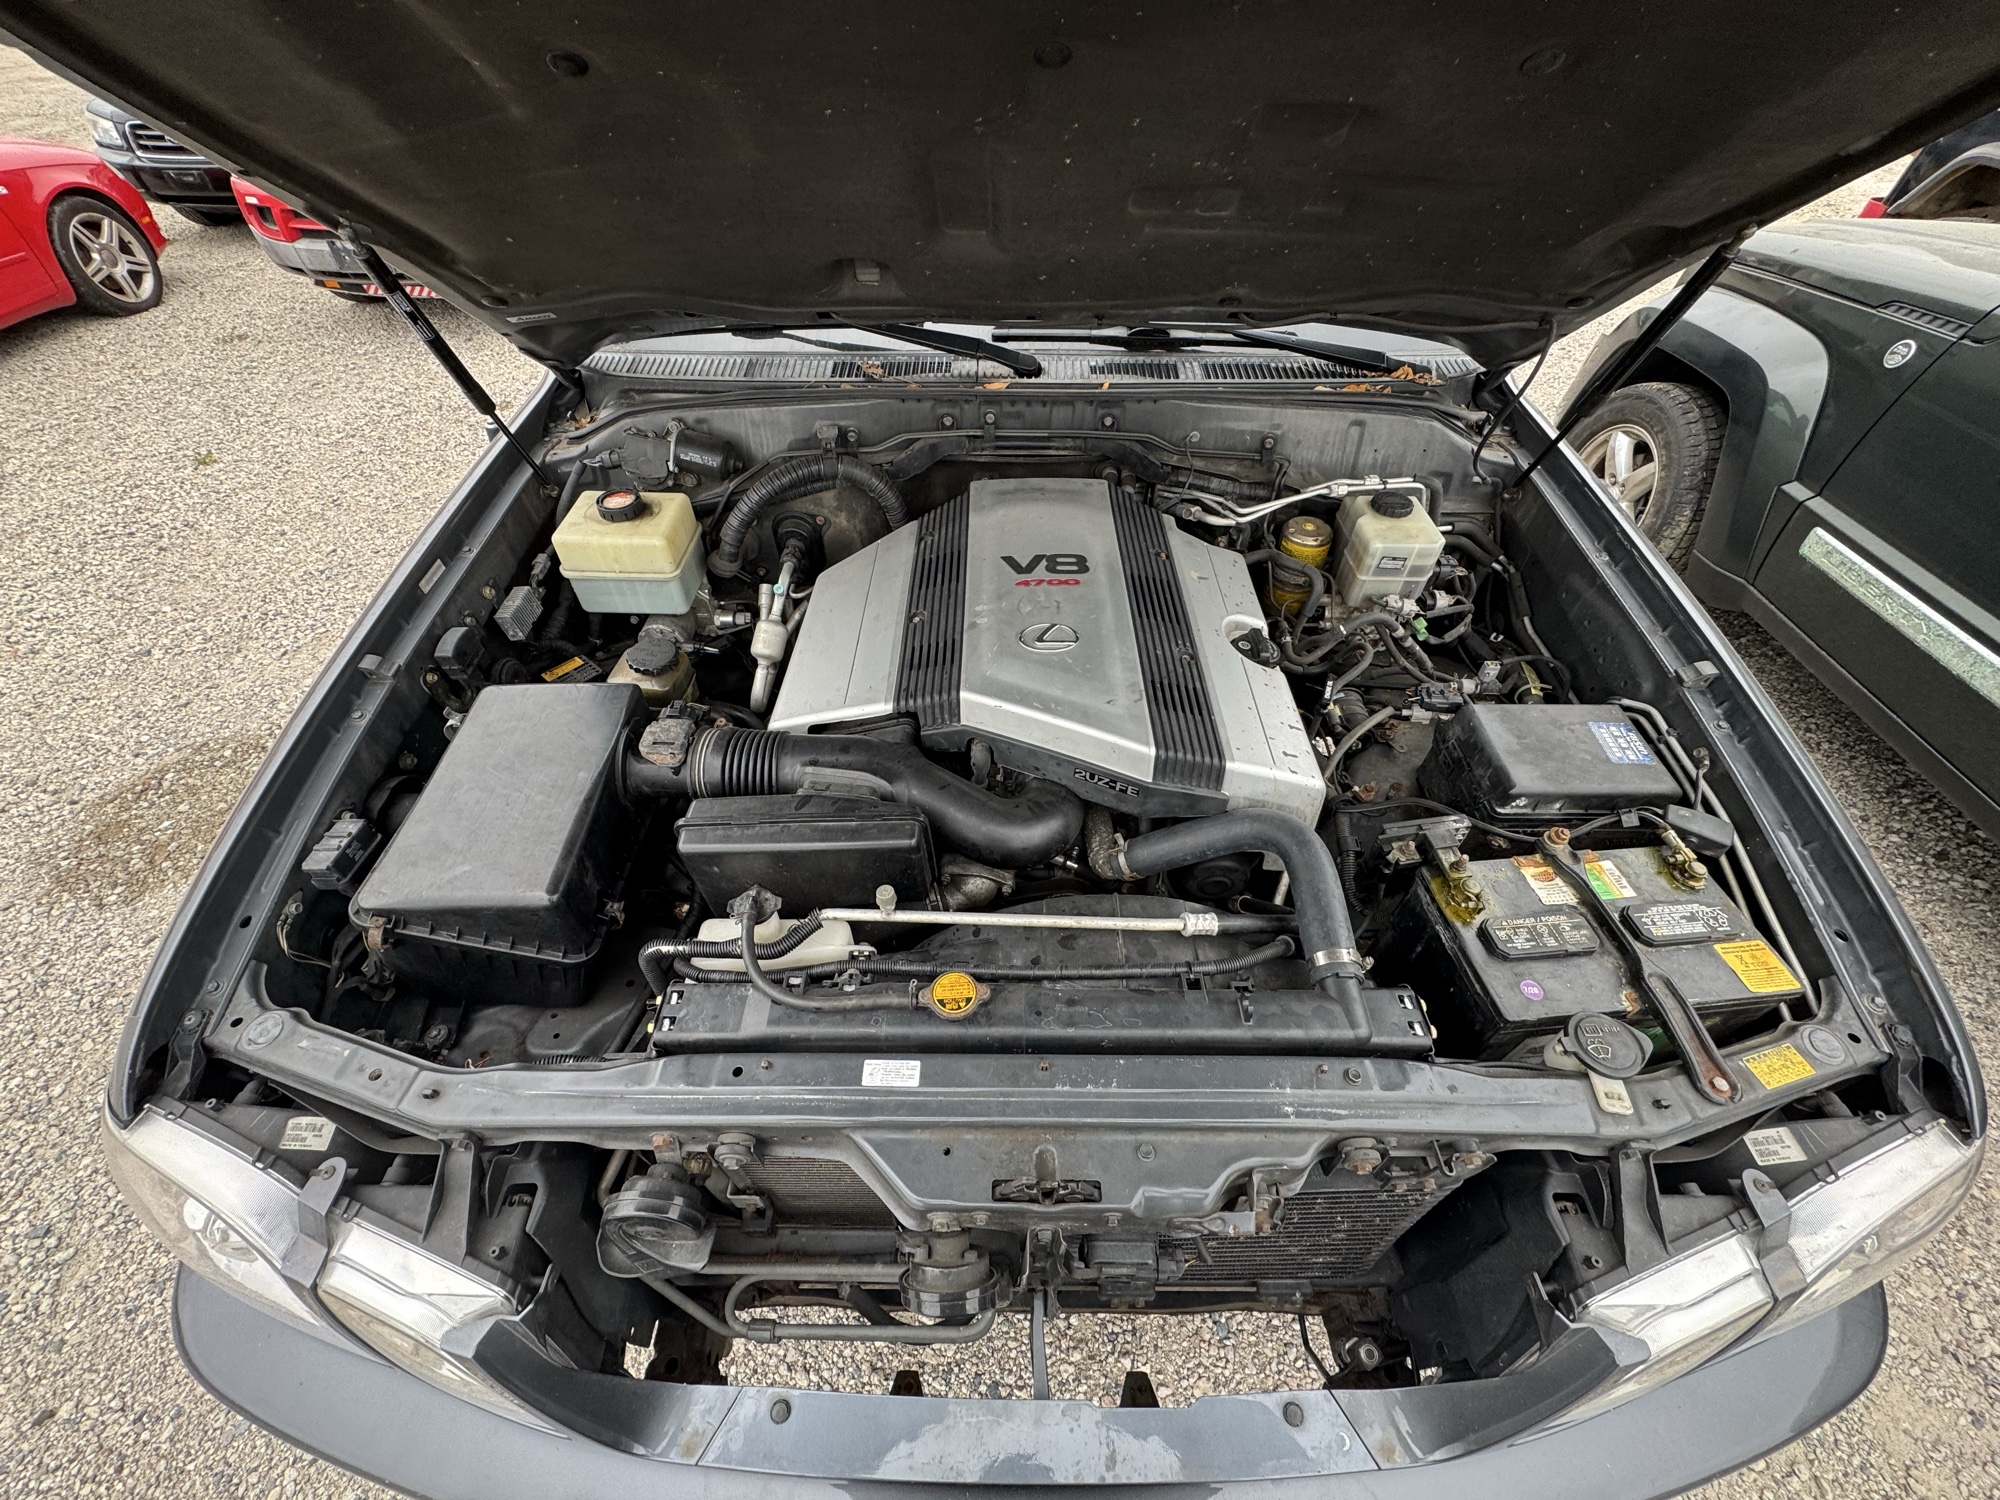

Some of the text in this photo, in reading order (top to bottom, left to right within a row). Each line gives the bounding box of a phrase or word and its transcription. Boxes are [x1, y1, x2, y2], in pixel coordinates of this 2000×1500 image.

[1000, 554, 1090, 575] V8
[1014, 578, 1081, 587] 4700
[1820, 550, 1946, 645] LIBERTY
[1074, 769, 1139, 797] 2UZ-FE
[1507, 917, 1535, 925] DANGER
